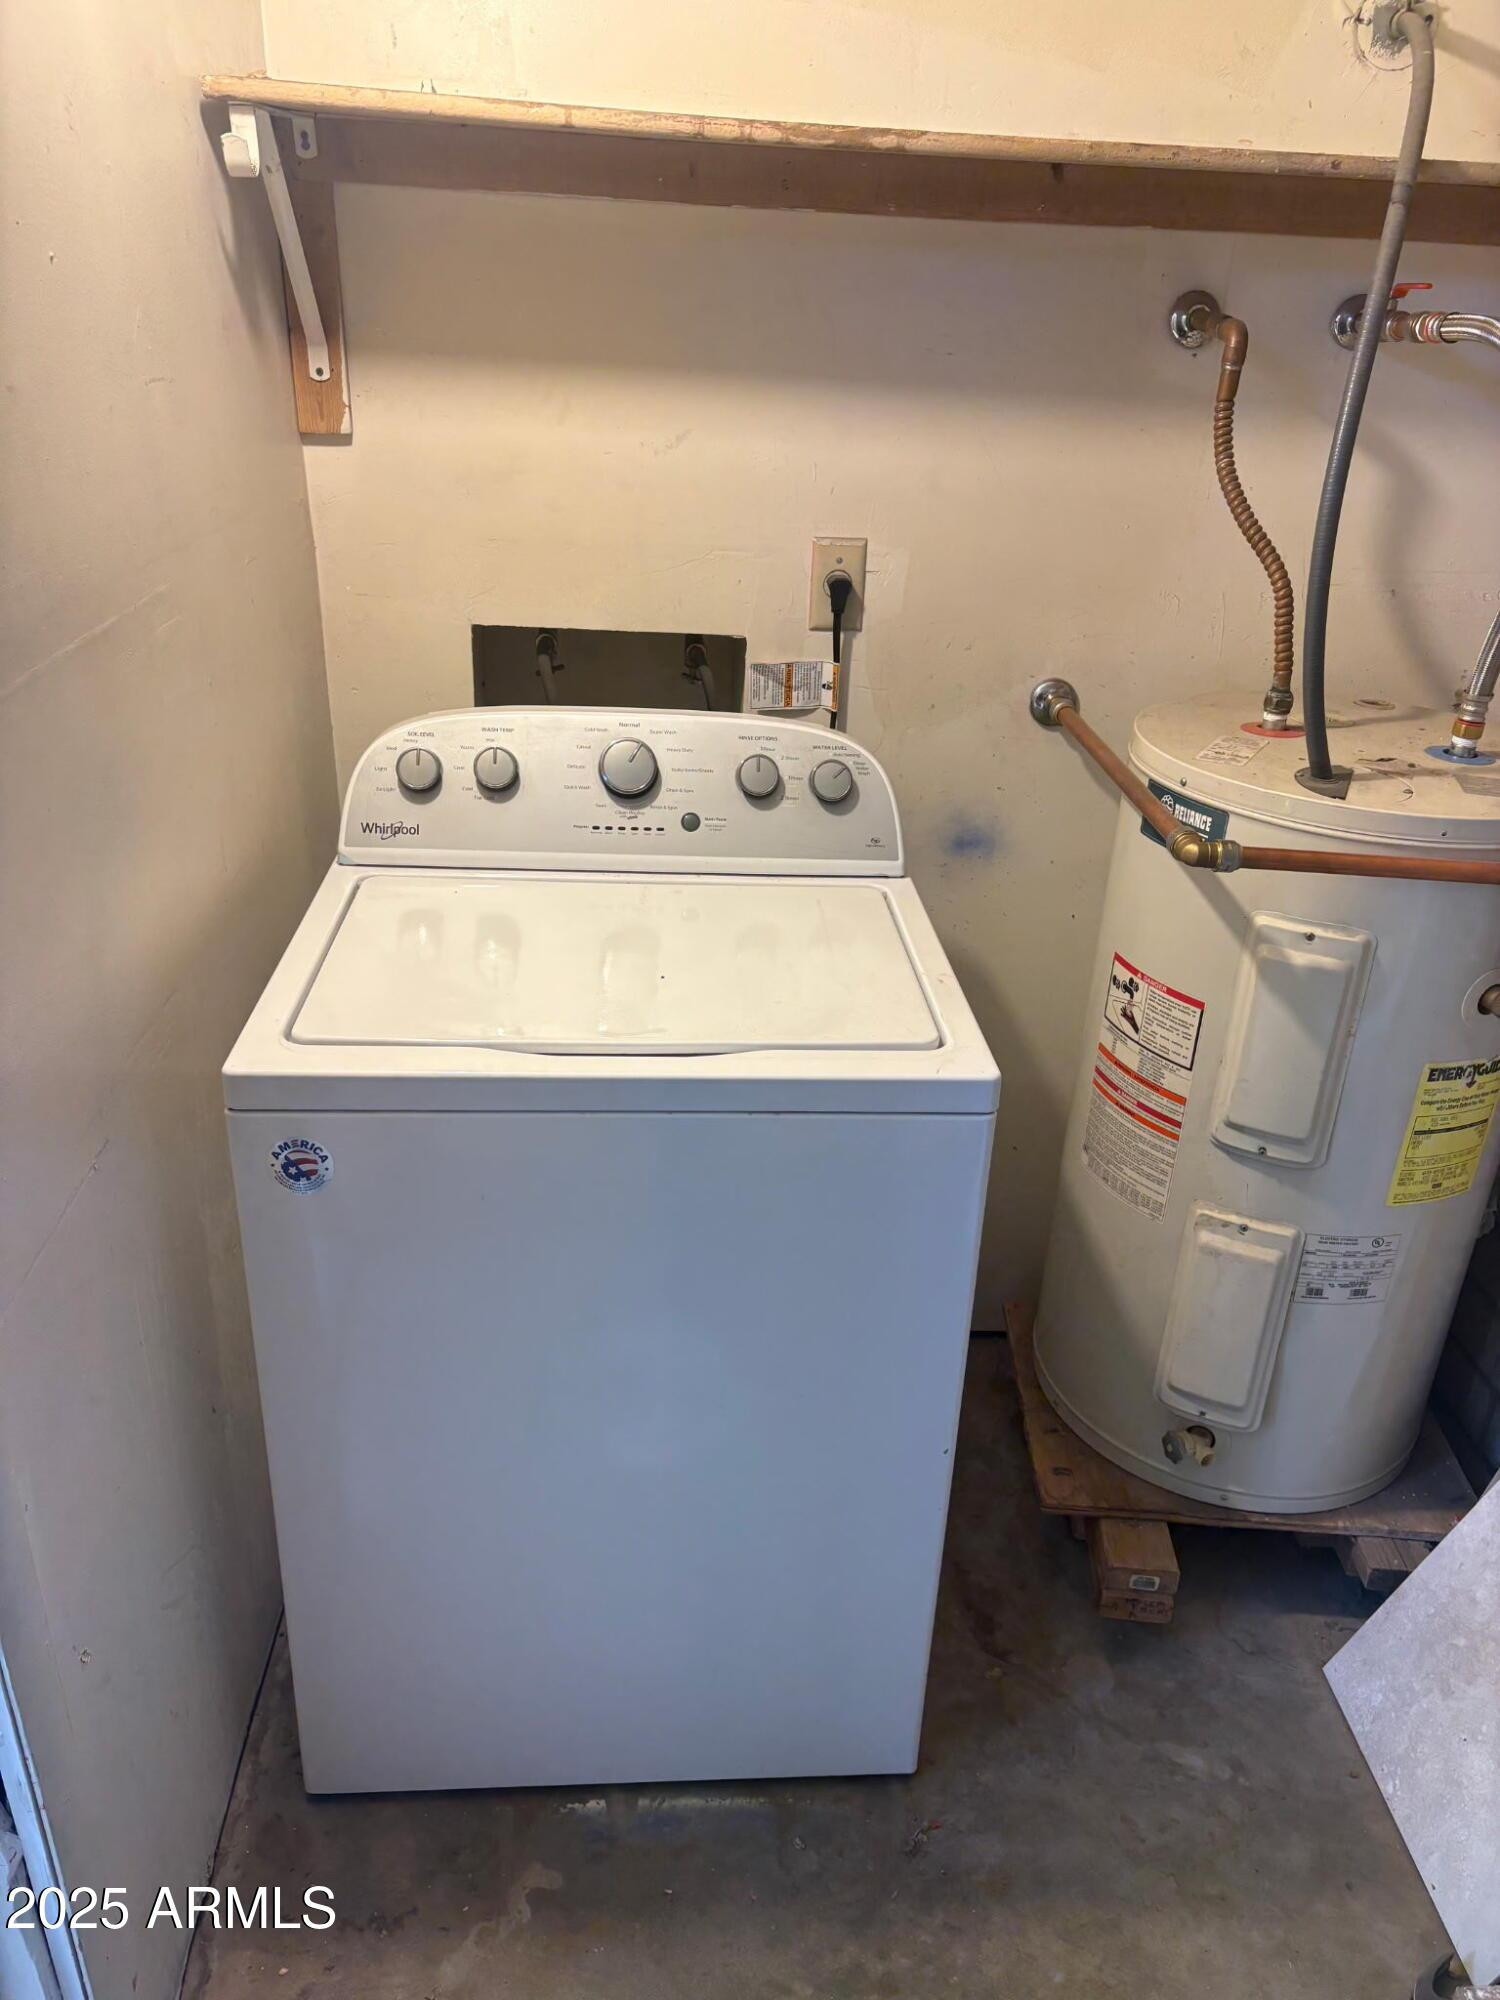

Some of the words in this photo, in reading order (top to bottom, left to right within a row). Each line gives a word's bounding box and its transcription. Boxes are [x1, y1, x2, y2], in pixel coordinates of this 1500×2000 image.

[1173, 803, 1213, 832] RELIANCE
[360, 820, 420, 840] Whirlpool
[271, 1139, 329, 1163] AMERICA
